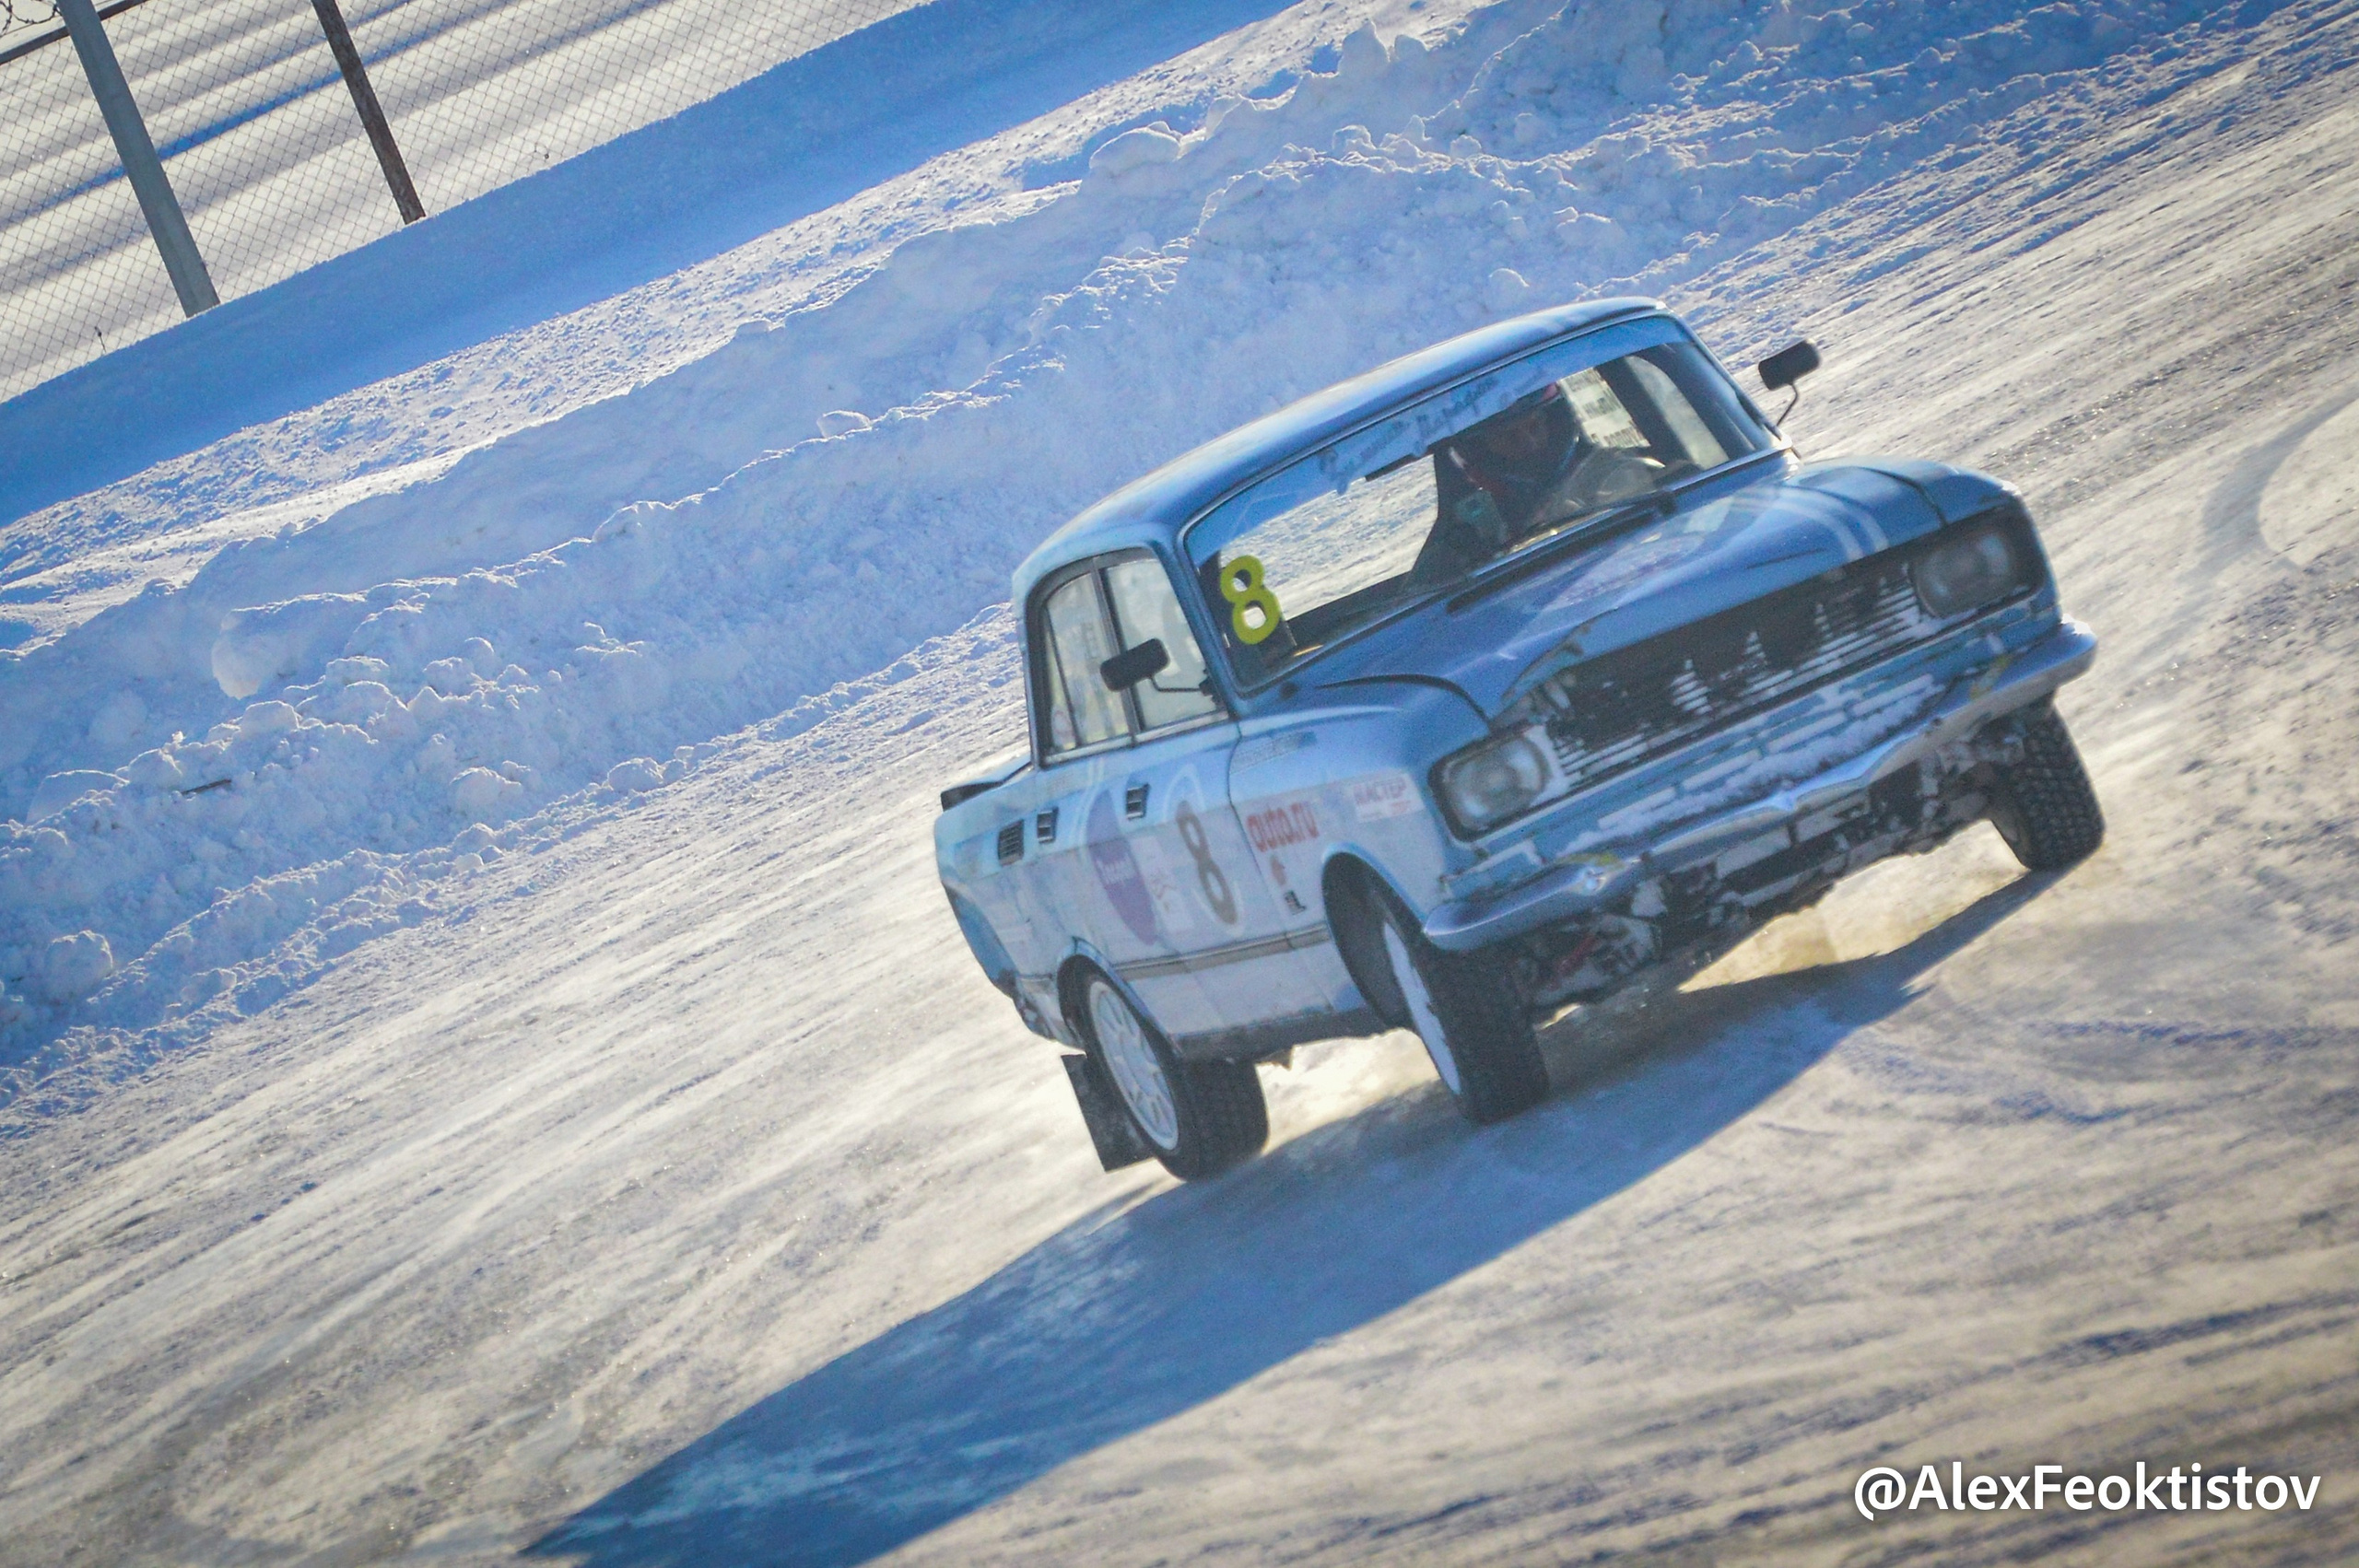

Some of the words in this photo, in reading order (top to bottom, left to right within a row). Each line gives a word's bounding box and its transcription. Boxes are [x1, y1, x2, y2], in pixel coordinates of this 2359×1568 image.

[1219, 555, 1281, 644] 8
[1176, 800, 1239, 925] 8
[1246, 801, 1320, 853] auto.ru
